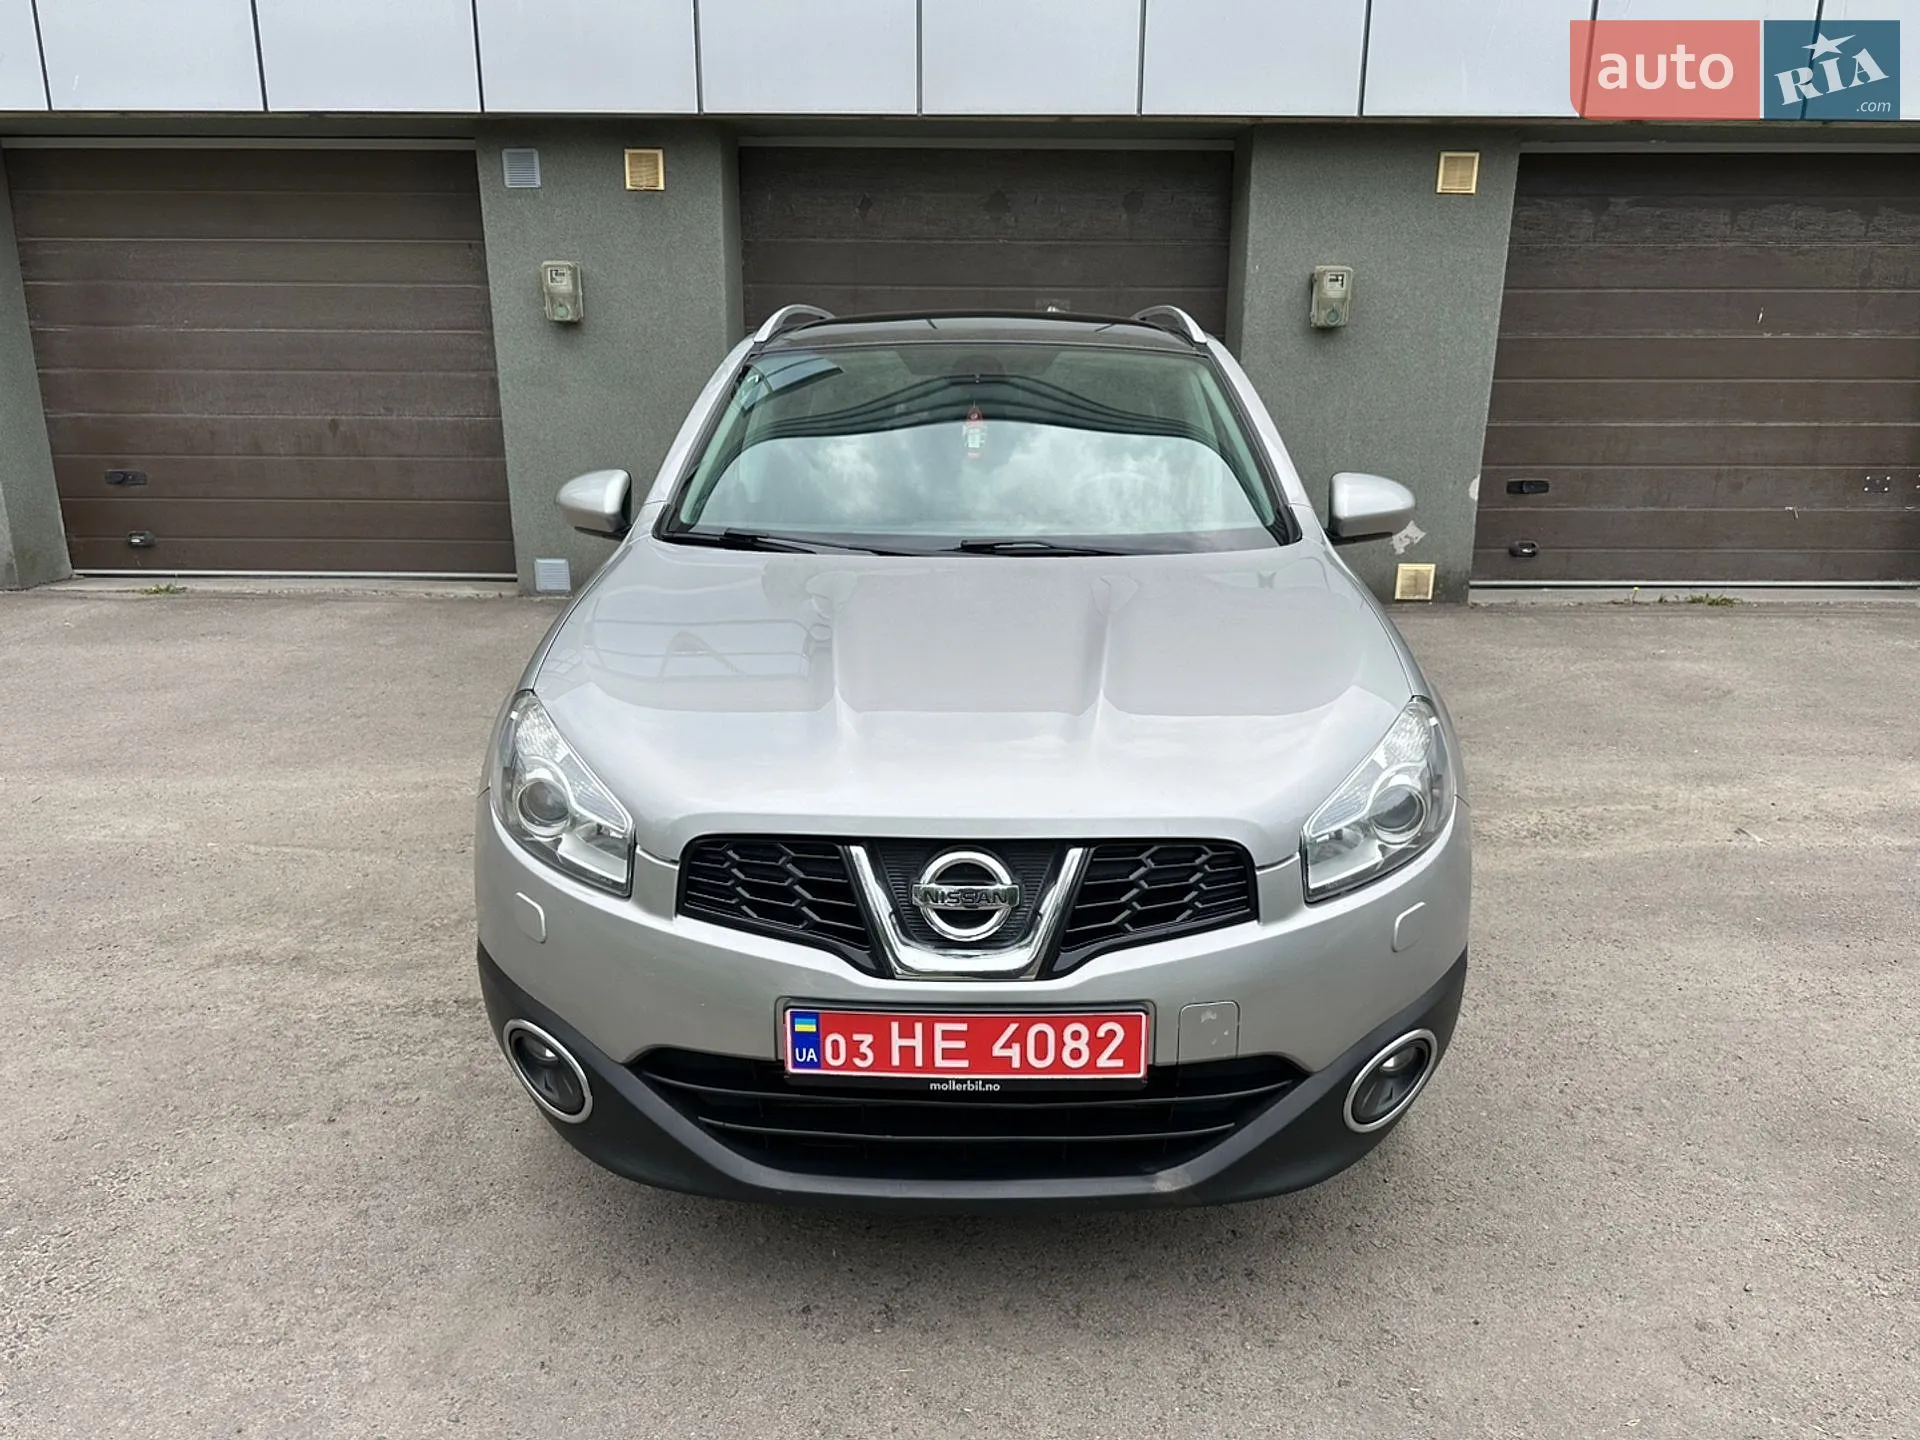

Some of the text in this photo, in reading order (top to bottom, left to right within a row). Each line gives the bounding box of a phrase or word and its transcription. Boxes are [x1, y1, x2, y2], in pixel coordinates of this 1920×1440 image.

[923, 890, 1007, 904] NISSAN
[824, 1021, 1126, 1069] 03 HE 4082
[795, 1048, 818, 1063] UA
[929, 1080, 1001, 1093] mollerbil.no
